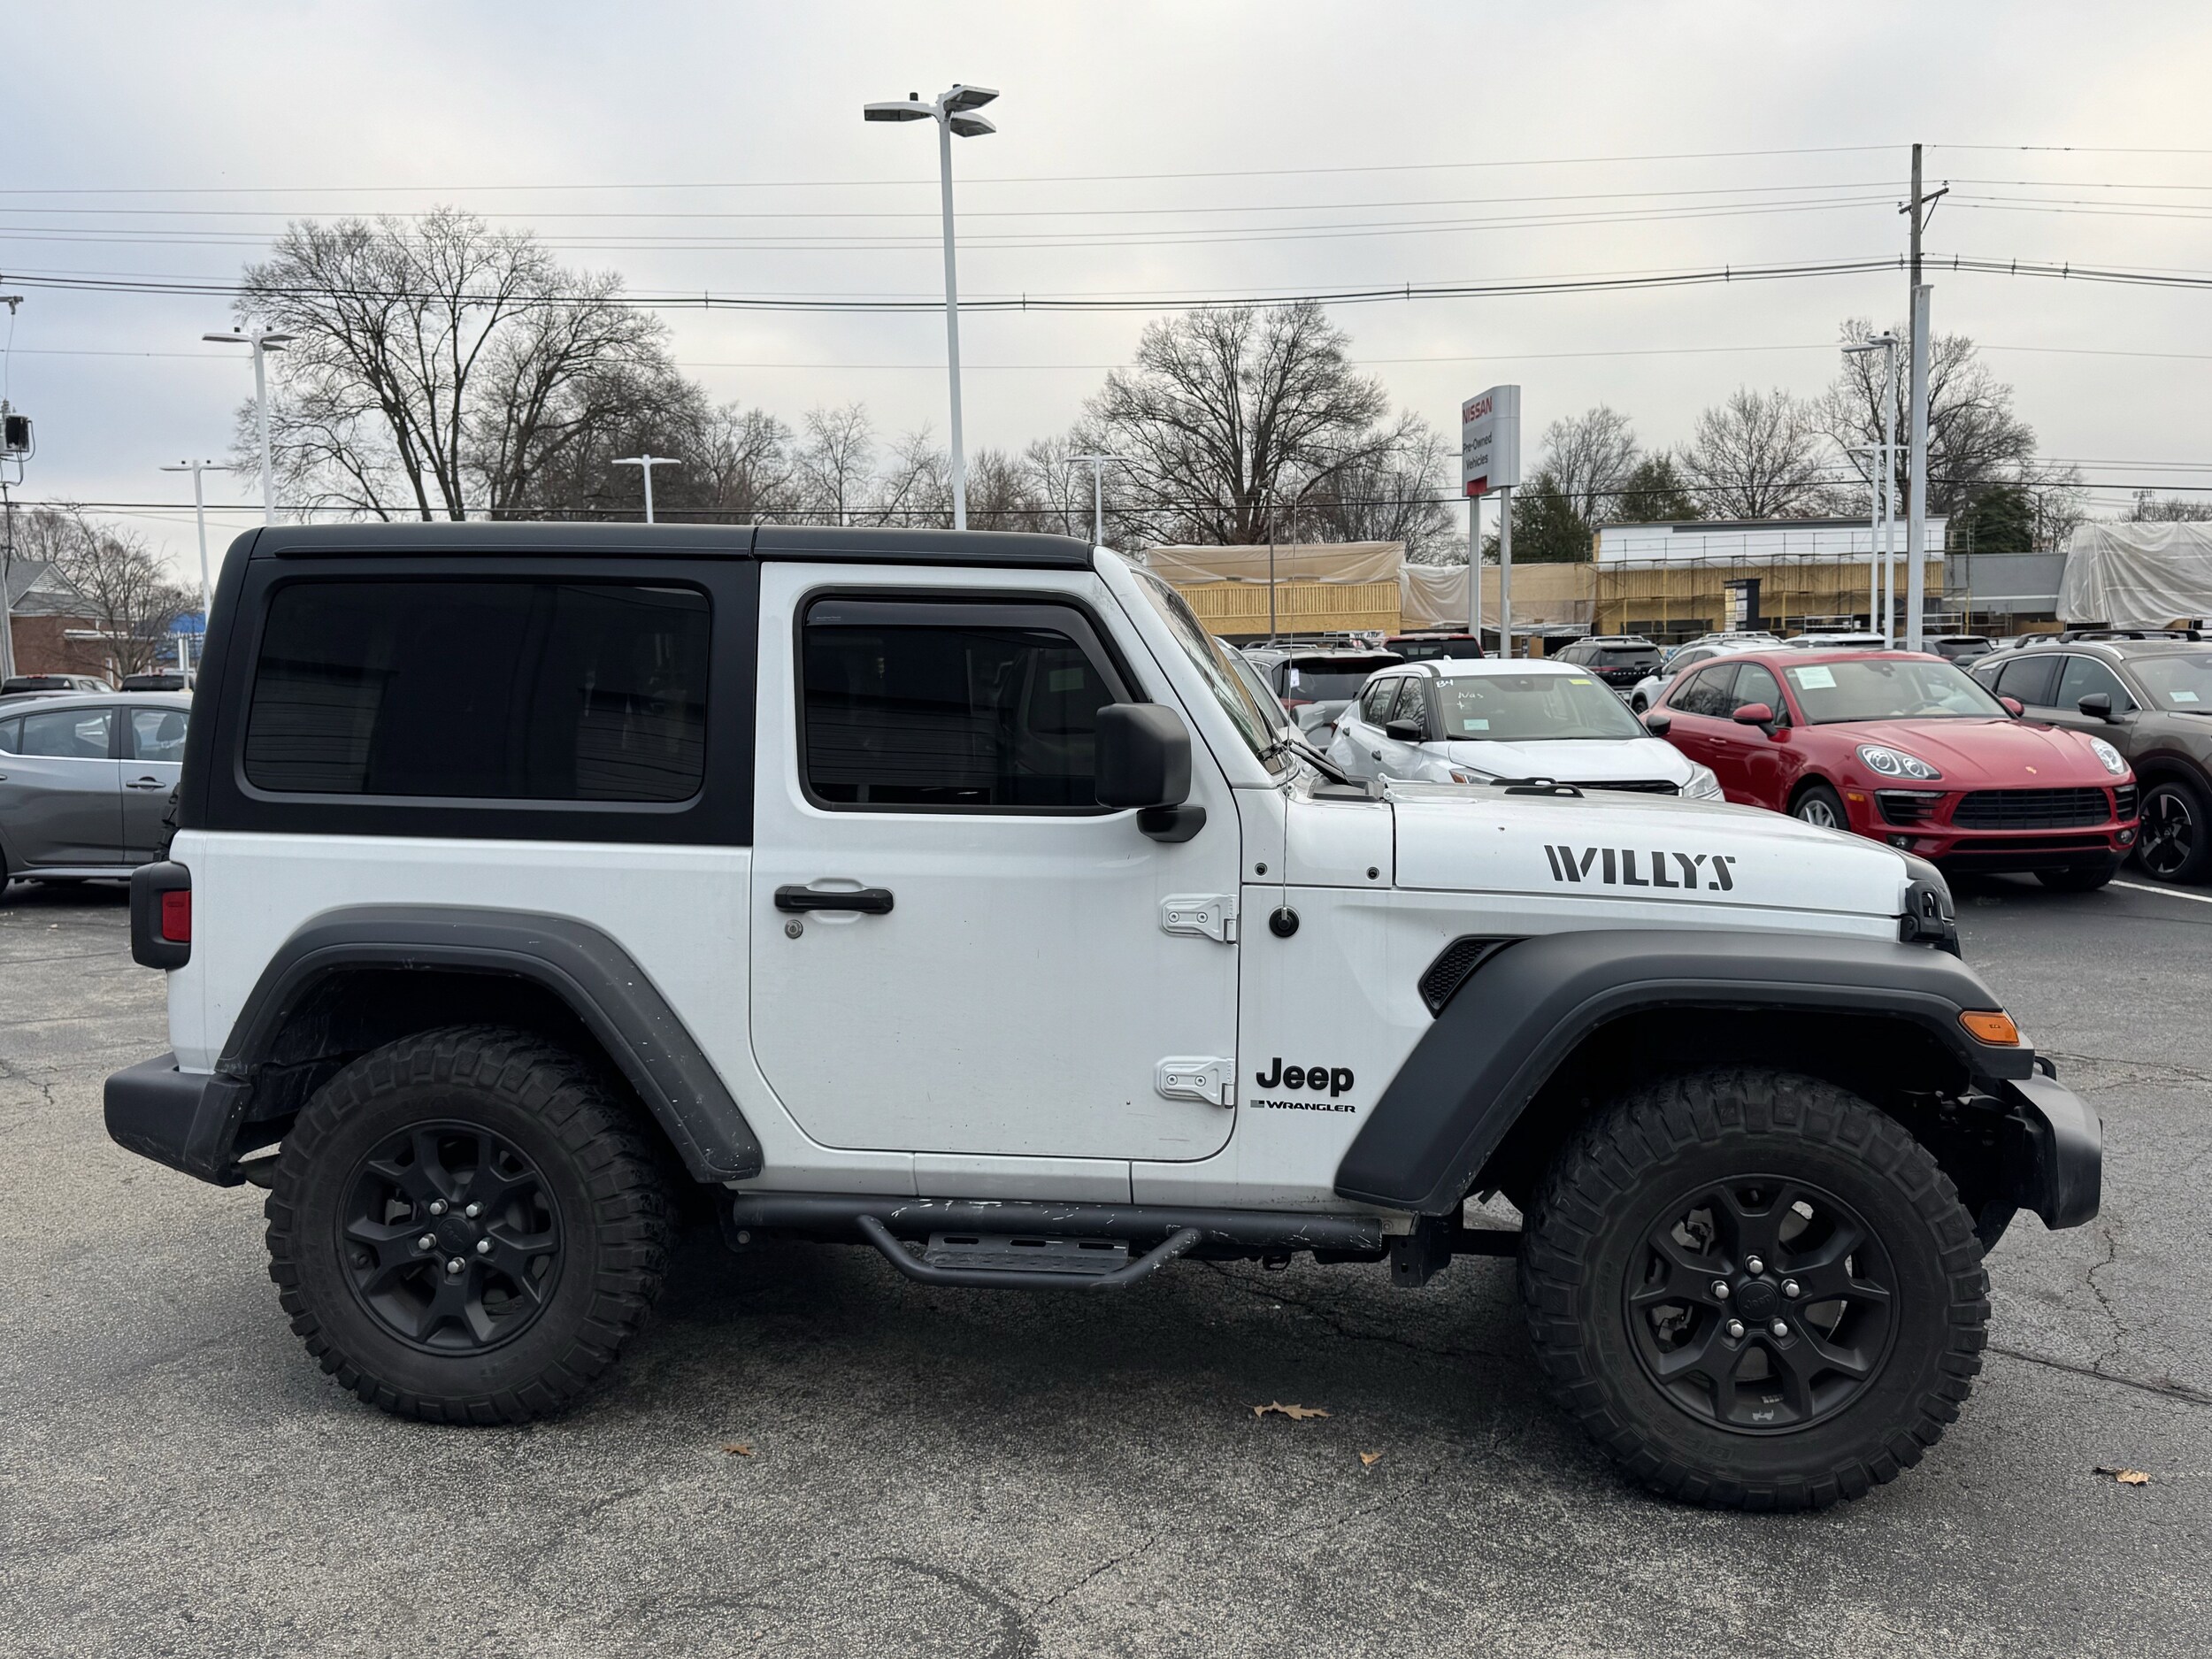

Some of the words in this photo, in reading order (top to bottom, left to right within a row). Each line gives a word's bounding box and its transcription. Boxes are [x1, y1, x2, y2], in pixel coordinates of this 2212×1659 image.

[1463, 396, 1493, 425] NISSAN
[1463, 432, 1493, 455] Pre-Owned
[1466, 454, 1488, 471] Vehicles
[1543, 844, 1736, 892] WILLYS
[1256, 1056, 1355, 1097] Jeep
[1266, 1100, 1356, 1113] WRANGLER
